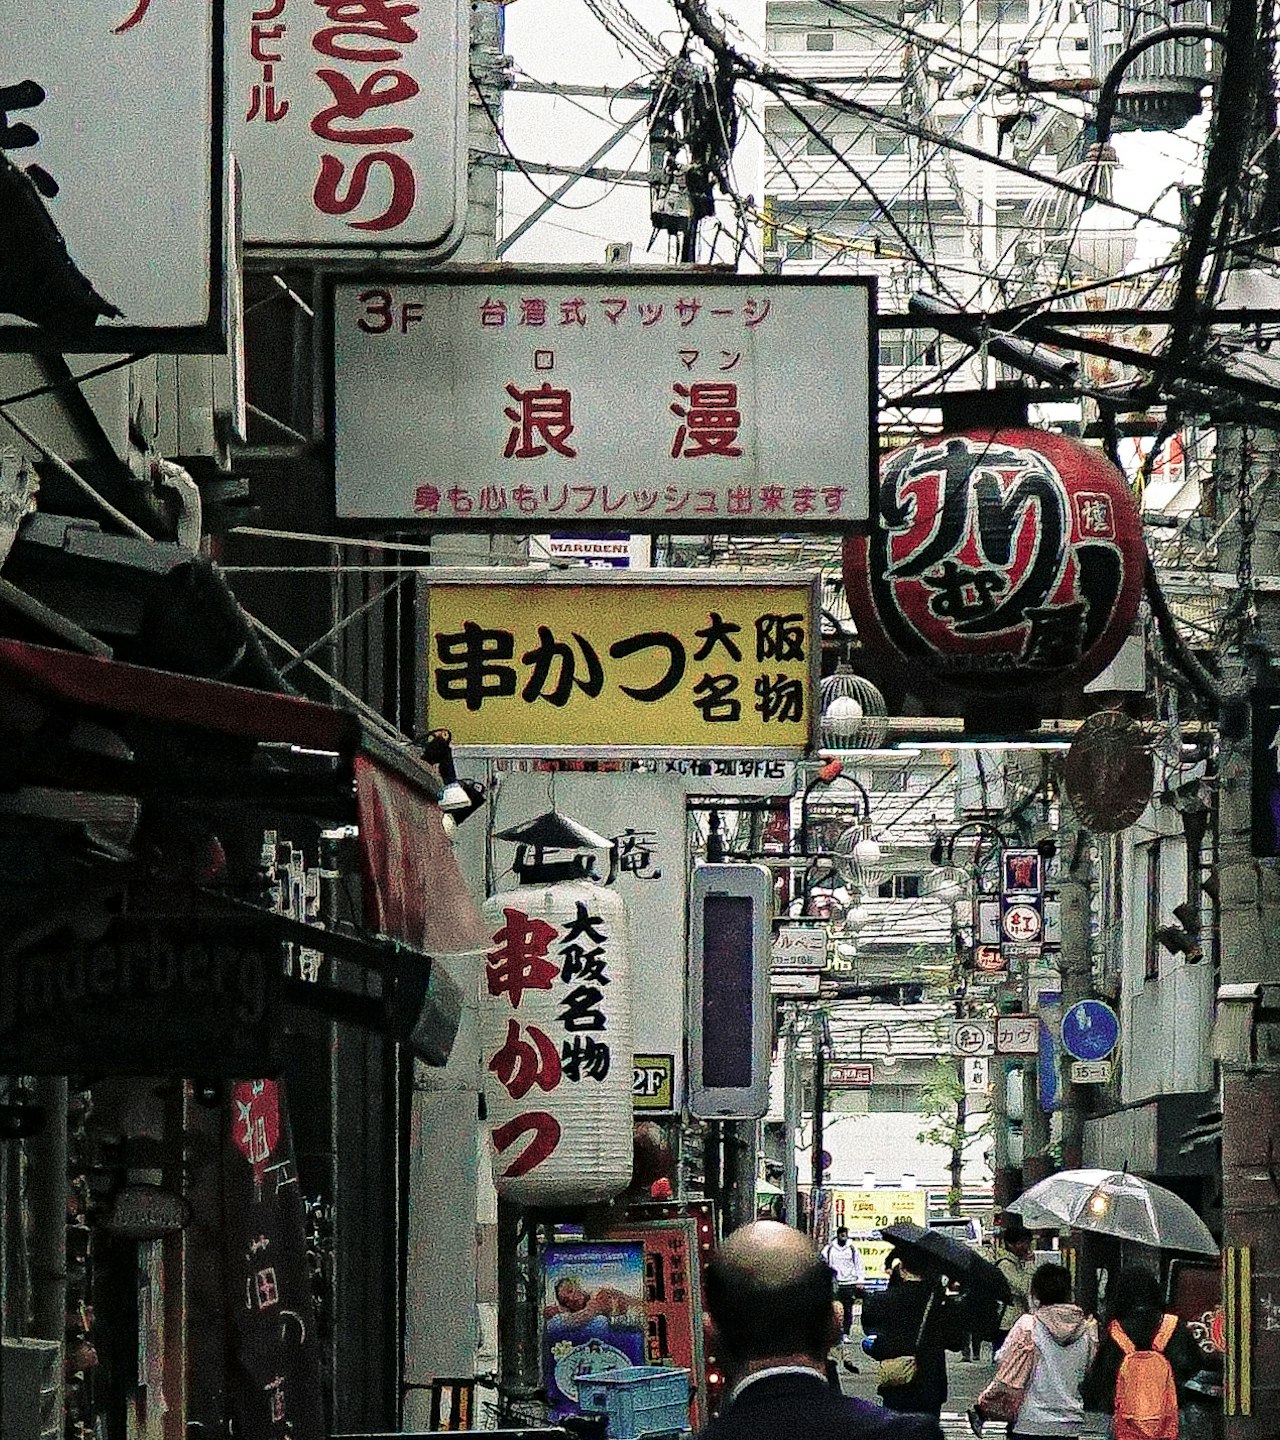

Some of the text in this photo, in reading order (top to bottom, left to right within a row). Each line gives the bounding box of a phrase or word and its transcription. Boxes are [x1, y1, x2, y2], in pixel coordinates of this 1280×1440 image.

[357, 291, 425, 335] 3F
[479, 296, 774, 330] 台湾式マッサージ
[503, 381, 744, 461] 浪漫
[413, 483, 848, 514] 身も心もリフレッシュ出来ます
[693, 612, 805, 664] 大阪
[434, 621, 687, 712] 串かつ
[692, 673, 805, 725] 名物
[556, 900, 610, 1083] 大阪名物
[487, 906, 561, 1178] 串かつ
